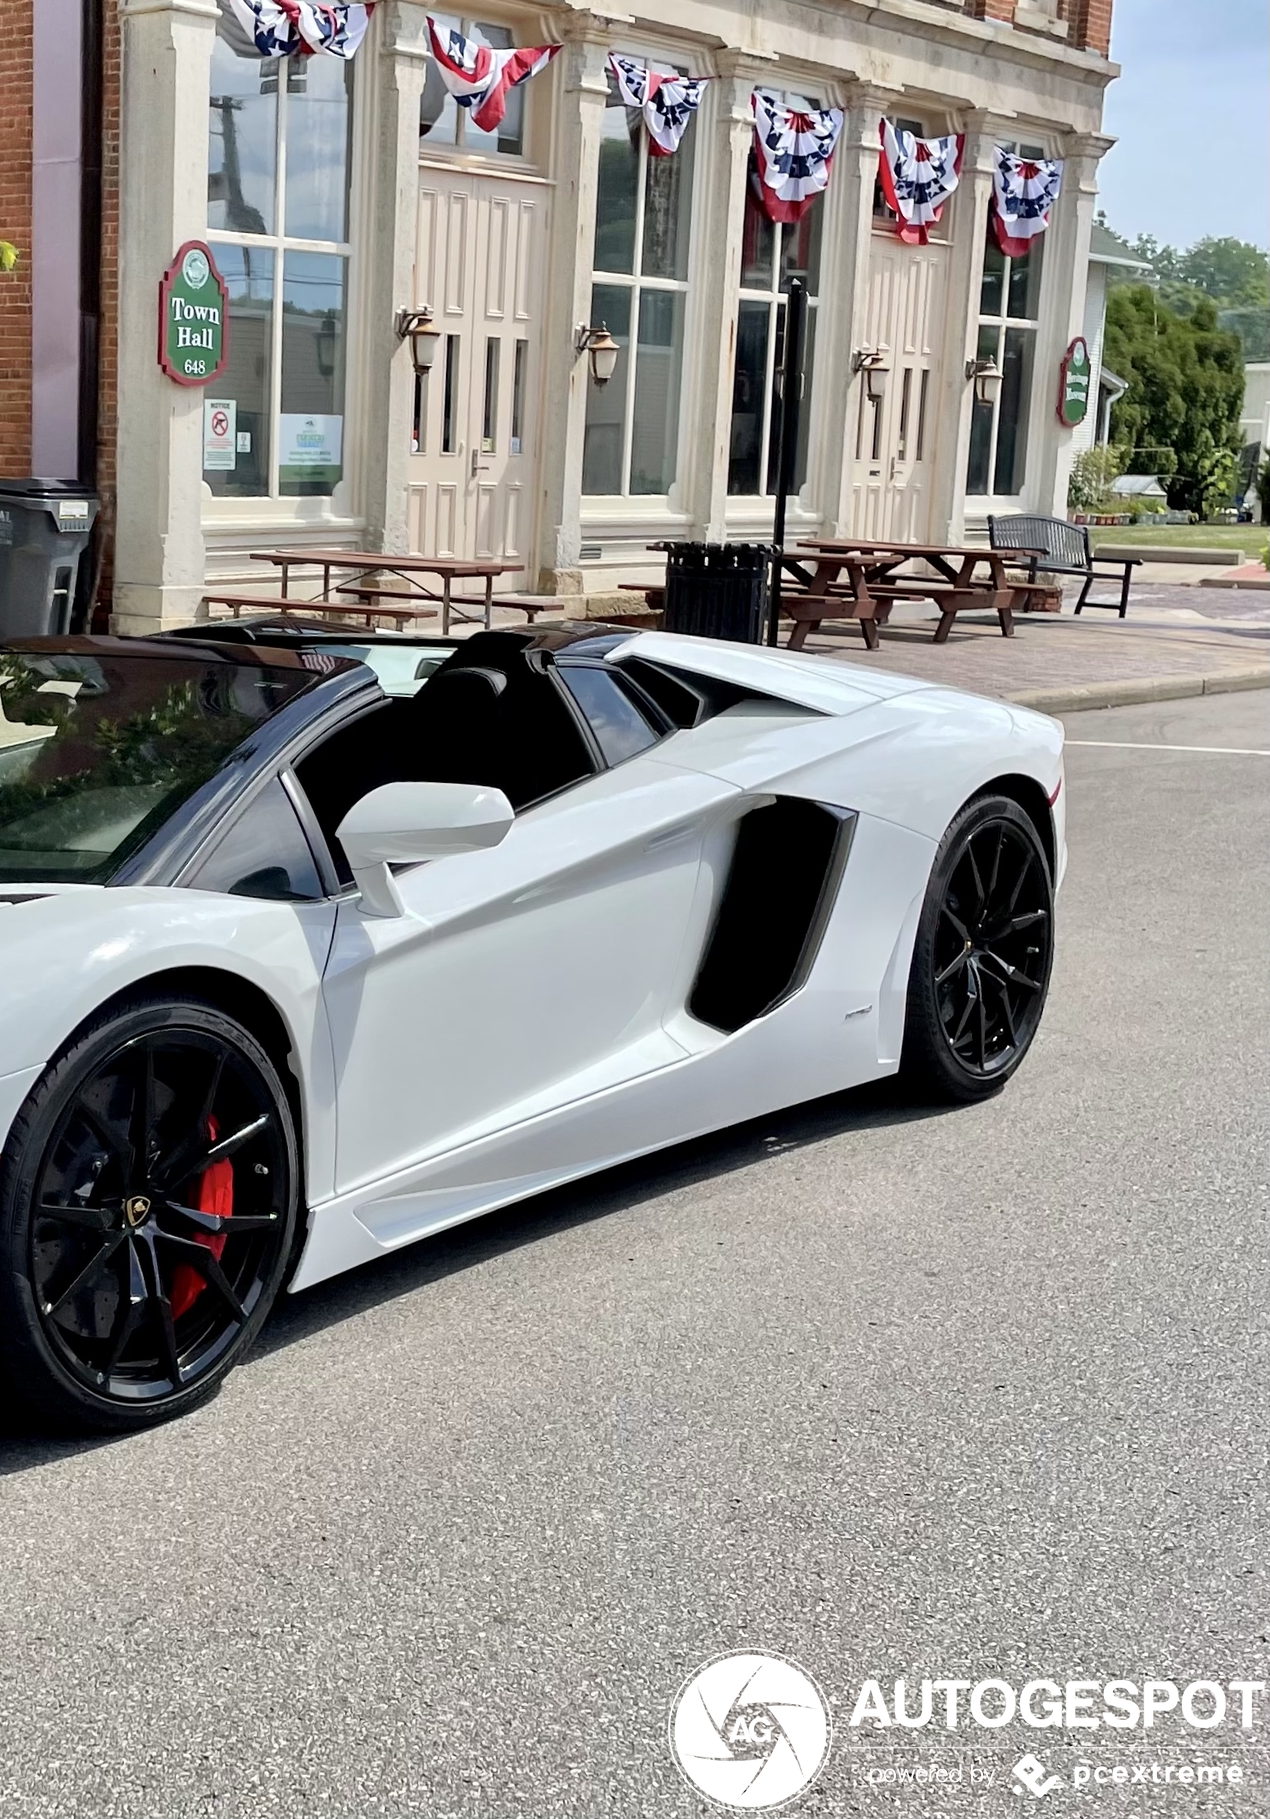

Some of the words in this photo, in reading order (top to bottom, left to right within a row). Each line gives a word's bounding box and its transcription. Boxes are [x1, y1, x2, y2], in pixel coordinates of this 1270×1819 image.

[171, 297, 220, 325] Town
[177, 326, 214, 350] Hall
[184, 359, 206, 374] 648
